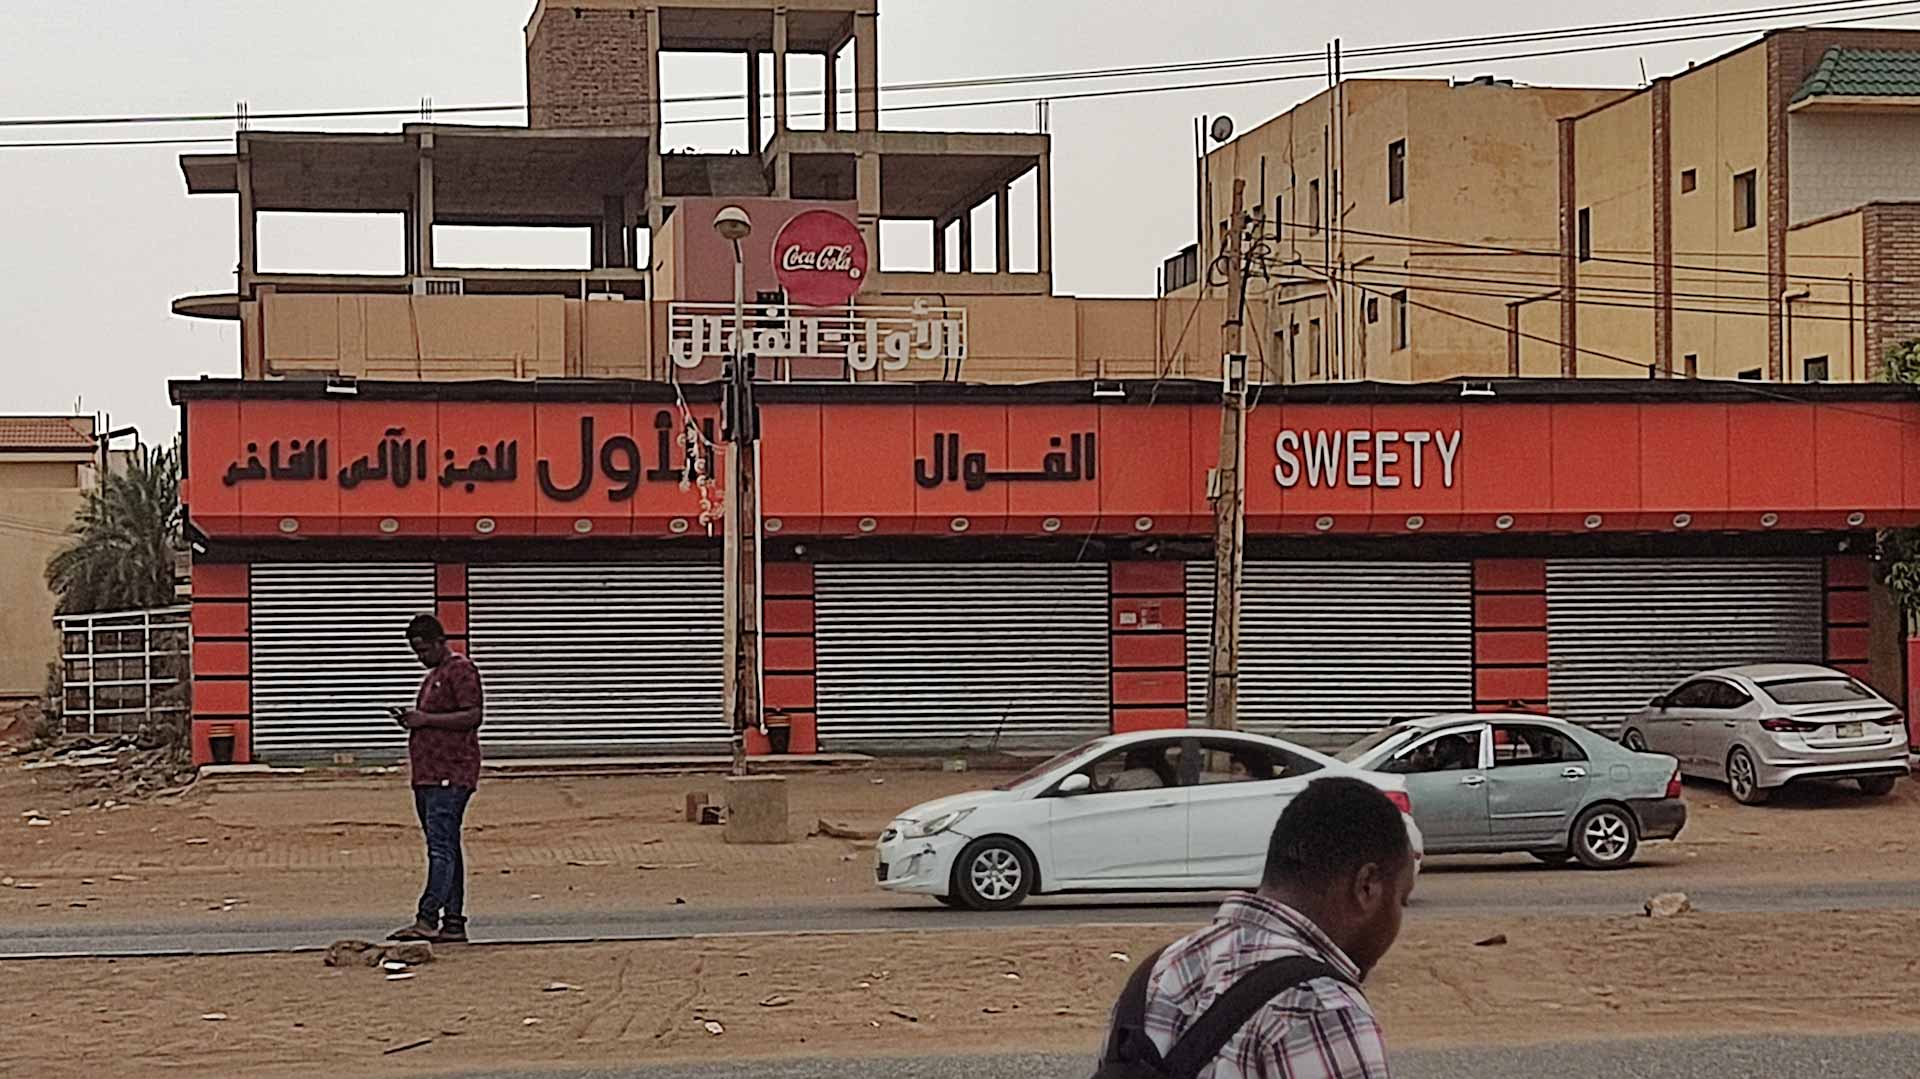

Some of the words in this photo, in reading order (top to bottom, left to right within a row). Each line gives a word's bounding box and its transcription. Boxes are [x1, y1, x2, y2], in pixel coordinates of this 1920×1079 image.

[222, 438, 328, 487] الفاخر
[914, 432, 1095, 491] الفوال
[1275, 430, 1461, 488] SWEETY
